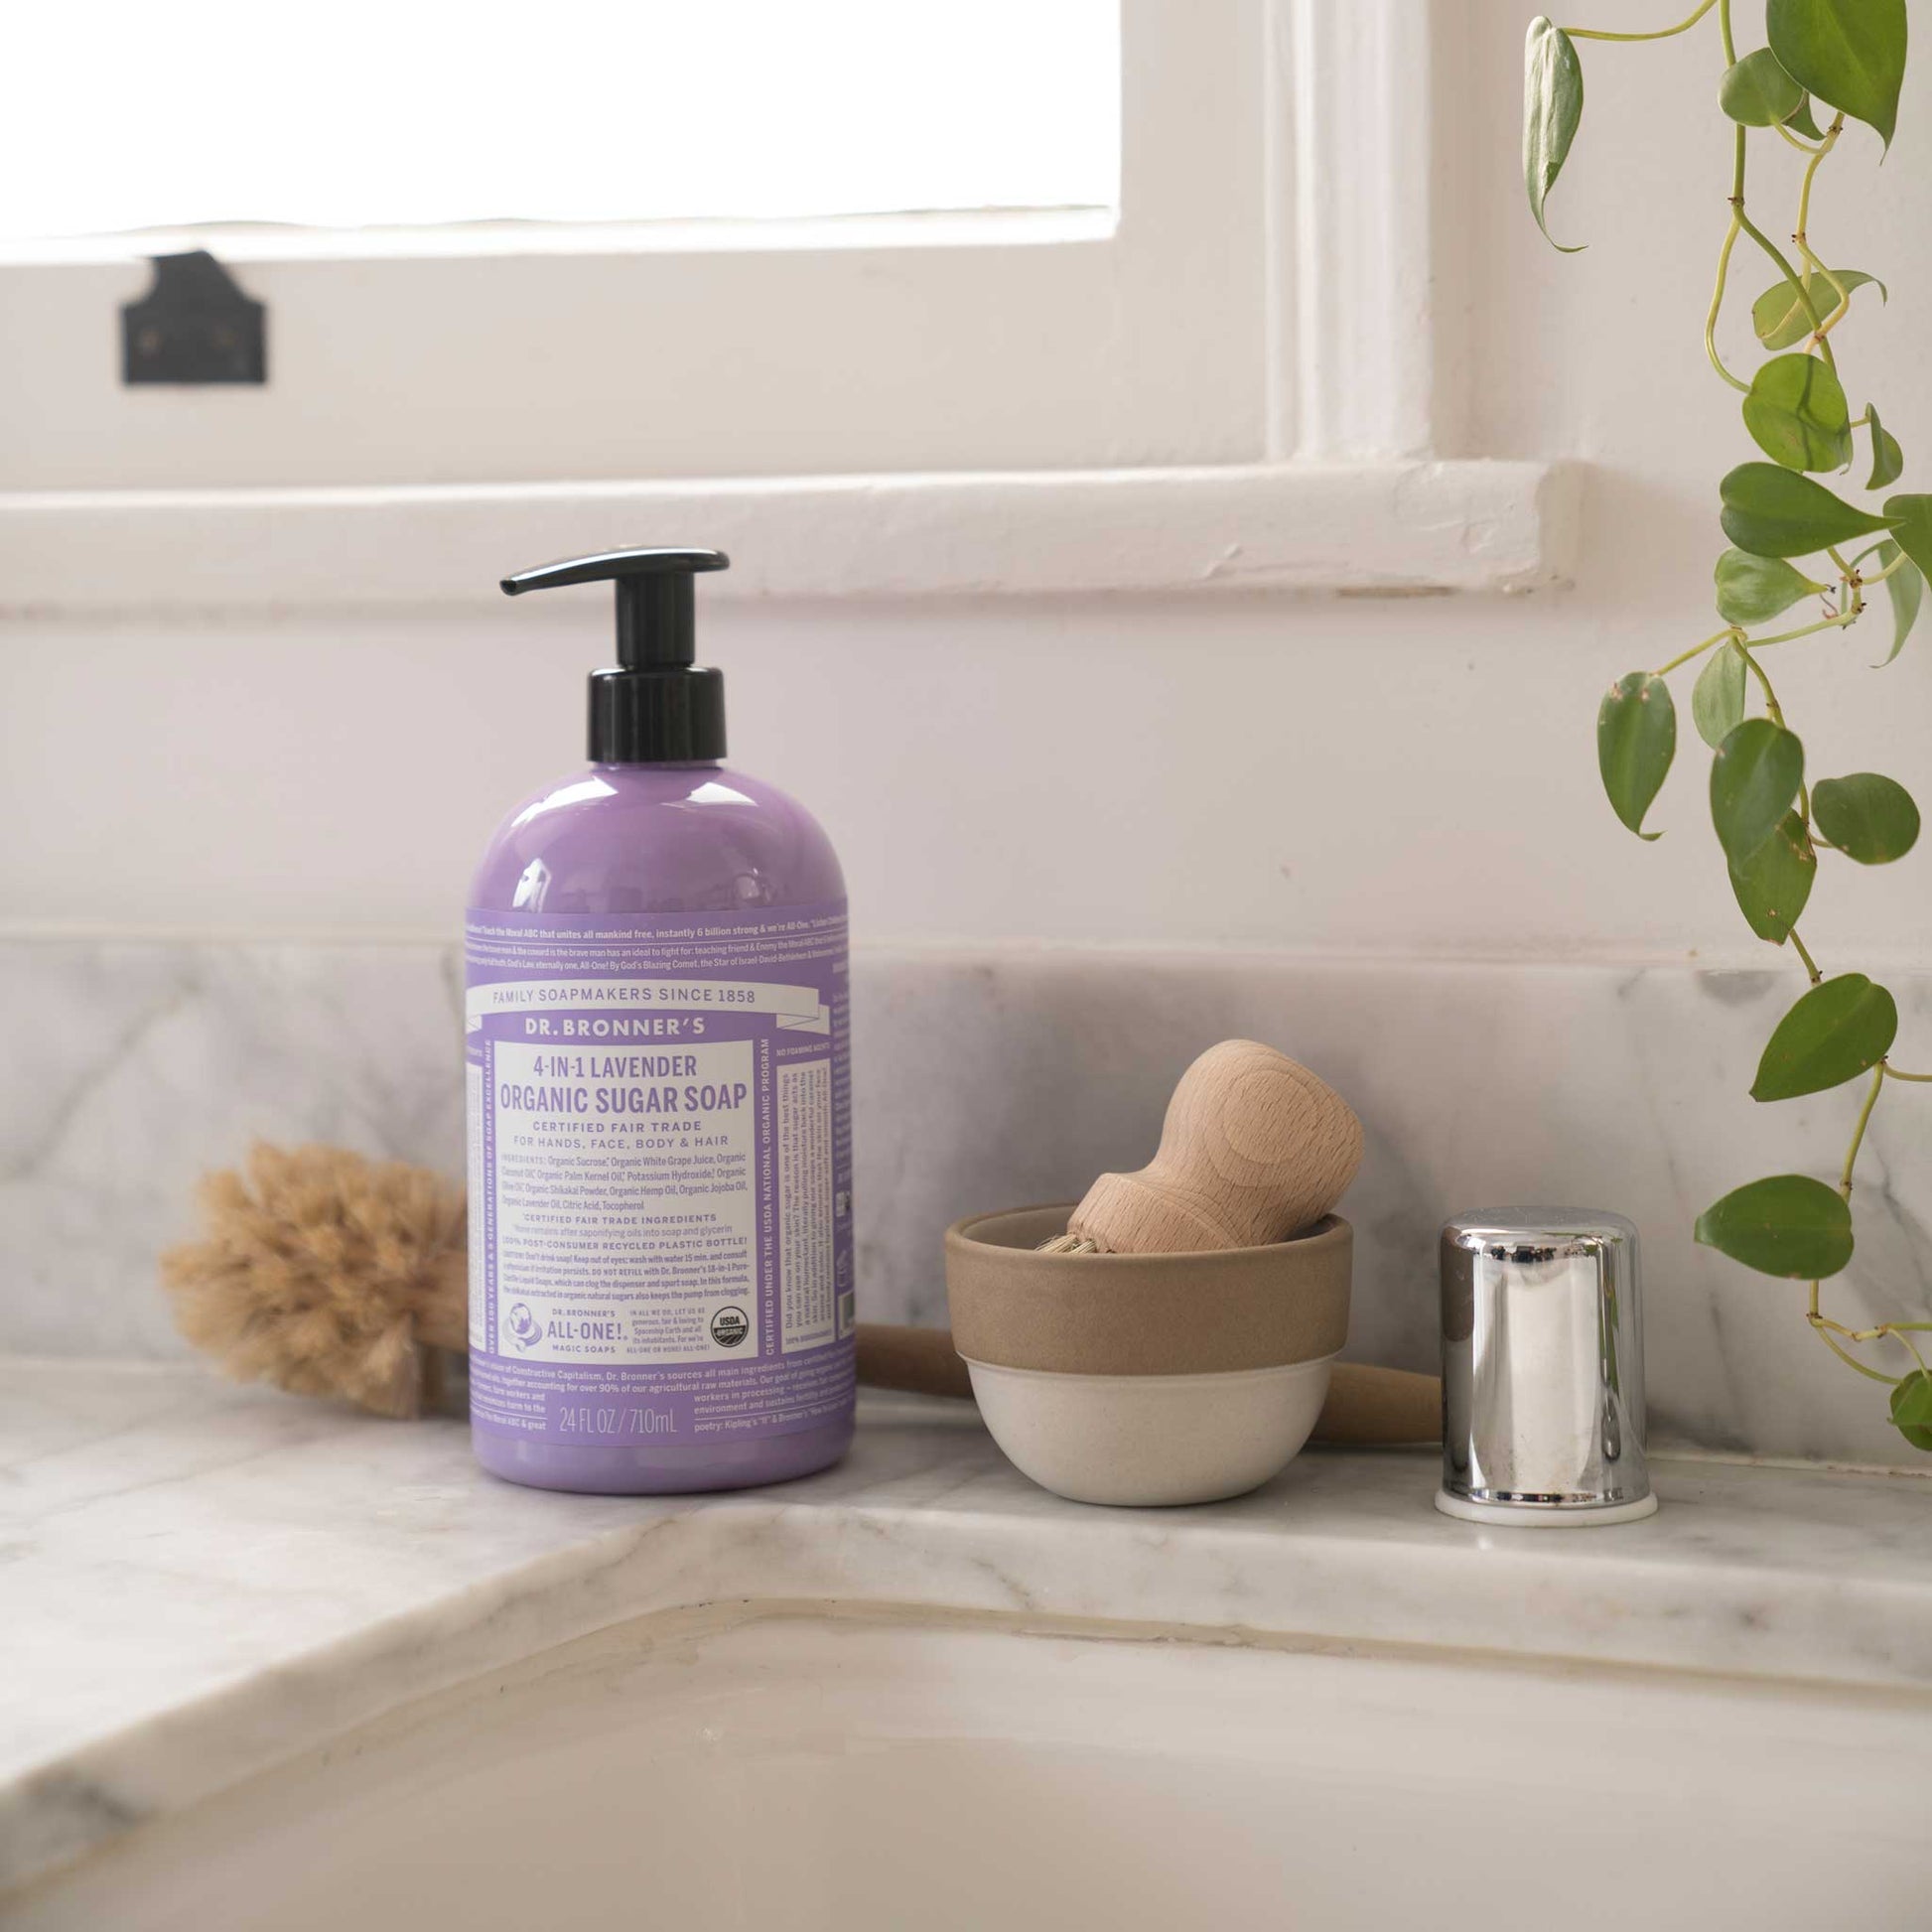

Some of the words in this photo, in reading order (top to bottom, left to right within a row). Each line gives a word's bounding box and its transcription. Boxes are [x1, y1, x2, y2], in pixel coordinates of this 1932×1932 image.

[540, 929, 555, 938] that
[557, 930, 581, 939] unites
[596, 929, 631, 938] mankind
[656, 929, 695, 938] instantly
[705, 926, 731, 936] billion
[733, 924, 758, 935] strong
[760, 923, 765, 932] &
[661, 947, 679, 957] fight
[695, 945, 727, 956] teaching
[728, 944, 749, 953] friend
[611, 961, 620, 971] By
[643, 959, 671, 970] Blazing
[701, 958, 713, 967] the
[714, 957, 728, 966] Star
[493, 991, 533, 1004] FAMILY
[538, 989, 651, 1001] SOAPMAKERS
[659, 989, 712, 1001] SINCE
[719, 990, 755, 1003] 1858
[564, 1018, 705, 1036] BRONNER'S
[534, 1056, 585, 1077] 4-IN-1
[591, 1055, 696, 1077] LAVENDER
[760, 1039, 769, 1091] PROGRAM
[781, 1074, 790, 1102] things
[500, 1084, 588, 1112] ORGANIC
[596, 1087, 677, 1114] SUGAR
[685, 1083, 747, 1112] SOAP
[533, 1121, 605, 1132] CERTIFIED
[612, 1123, 644, 1133] FAIR
[651, 1121, 701, 1132] TRADE
[761, 1095, 770, 1144] ORGANIC
[514, 1136, 533, 1146] FOR
[636, 1139, 674, 1149] BODY
[680, 1138, 689, 1148] &
[695, 1136, 728, 1146] HAIR
[548, 1156, 575, 1168] Organic
[611, 1157, 641, 1169] Organic
[643, 1157, 666, 1166] White
[668, 1156, 691, 1167] Grape
[717, 1153, 746, 1166] Organic
[537, 1171, 563, 1180] Organic
[585, 1172, 609, 1180] Kernel
[627, 1172, 669, 1180] Potassium
[717, 1168, 746, 1178] Organic
[762, 1147, 771, 1200] NATIONAL
[610, 1186, 639, 1198] Organic
[641, 1186, 663, 1196] Hemp
[679, 1184, 709, 1196] Organic
[712, 1183, 735, 1193] Jojoba
[783, 1184, 792, 1209] sugar
[563, 1199, 582, 1209] Citric
[603, 1201, 644, 1211] Tocopherol
[642, 1214, 716, 1224] INGREDIENTS
[763, 1204, 772, 1232] USDA
[579, 1229, 625, 1239] saponifying
[627, 1228, 641, 1237] oils
[662, 1228, 681, 1237] soap
[700, 1225, 732, 1236] glycerin
[783, 1213, 792, 1245] organic
[659, 1240, 703, 1249] PLASTIC
[764, 1260, 773, 1296] UNDER
[651, 1292, 670, 1301] keeps
[683, 1291, 703, 1300] pump
[720, 1316, 740, 1326] USDA
[765, 1301, 774, 1355] CERTIFIED
[548, 1321, 622, 1340] ALL-ONE!
[667, 1371, 702, 1380] sources
[741, 1362, 784, 1375] ingredients
[599, 1384, 619, 1393] 90%
[649, 1381, 699, 1394] agricultural
[701, 1381, 717, 1390] raw
[742, 1386, 784, 1398] processing
[695, 1401, 747, 1414] environment
[560, 1407, 576, 1432] 24
[579, 1408, 594, 1433] FL
[598, 1409, 615, 1434] OZ
